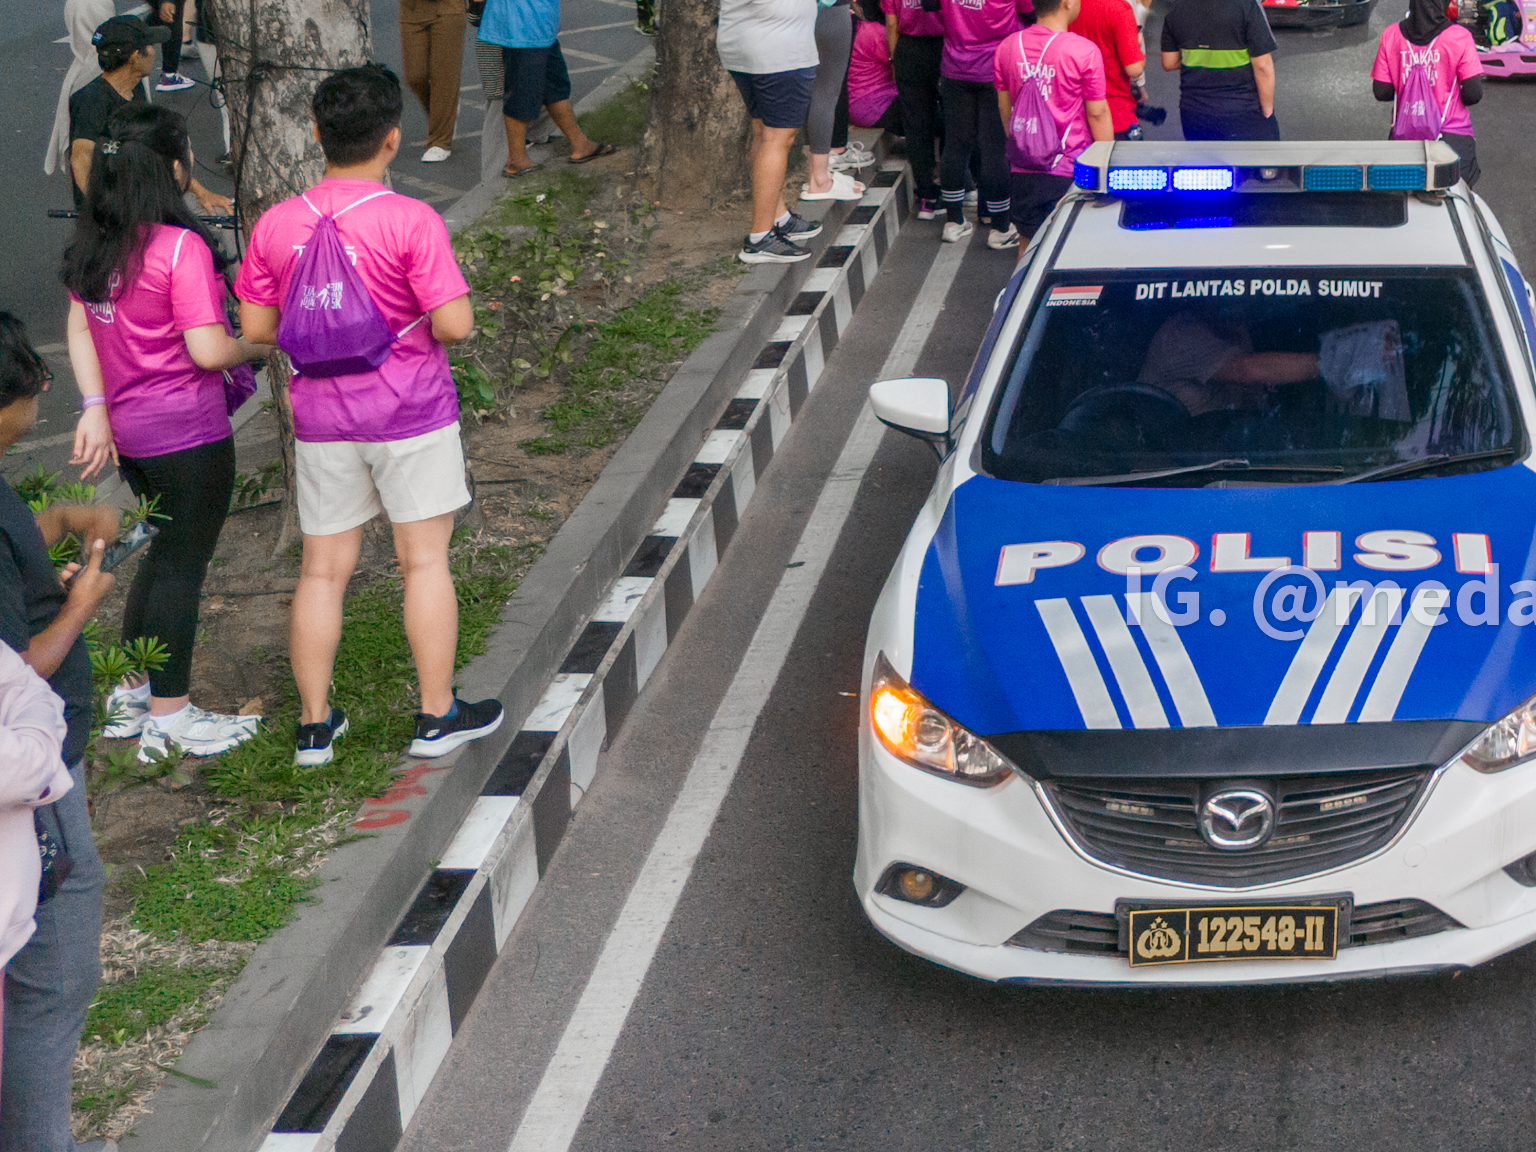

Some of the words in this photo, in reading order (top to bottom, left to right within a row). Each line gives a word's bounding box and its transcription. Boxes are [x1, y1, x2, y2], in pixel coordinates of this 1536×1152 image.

[1046, 298, 1097, 307] INDONESIA
[1136, 283, 1168, 300] DIT
[1172, 280, 1246, 298] LANTAS
[1250, 279, 1311, 296] POLDA
[1317, 280, 1383, 298] SUMUT
[994, 529, 1494, 587] POLISI
[1196, 915, 1326, 953] 122548-II
